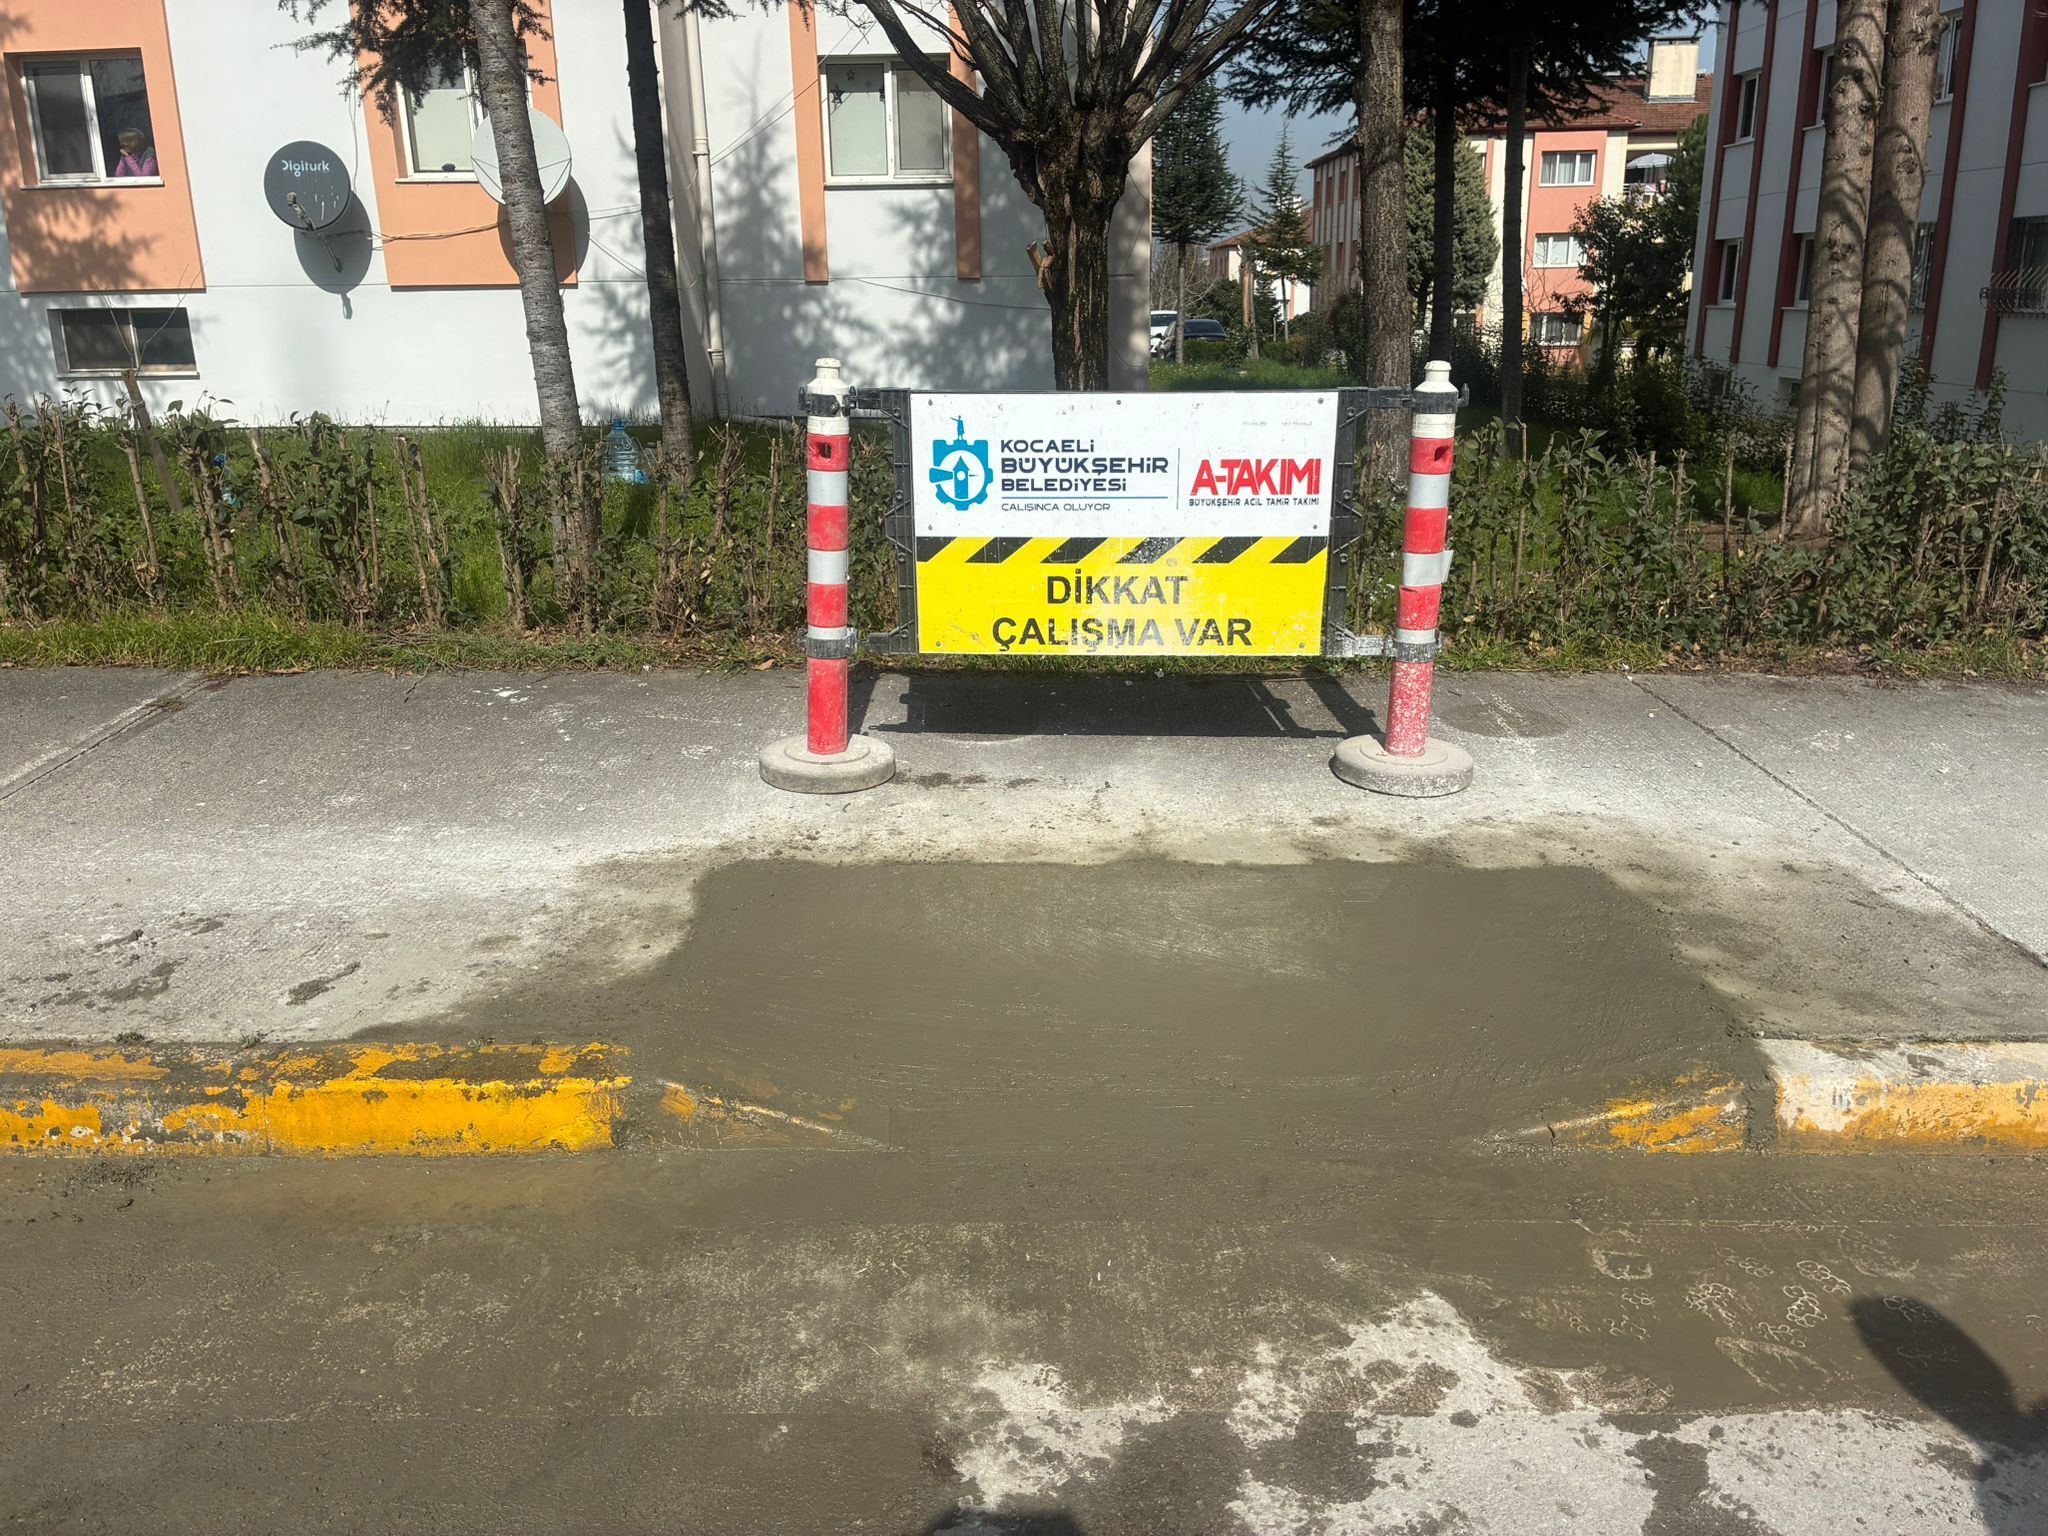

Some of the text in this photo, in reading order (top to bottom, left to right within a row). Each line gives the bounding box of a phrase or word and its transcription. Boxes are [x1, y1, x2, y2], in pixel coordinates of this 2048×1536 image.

[281, 159, 330, 177] Digiturk
[1001, 439, 1094, 453] KOCAELİ
[1001, 457, 1168, 476] BÜYÜKŞEHİR
[1001, 478, 1127, 492] BELEDİYESİ
[1190, 458, 1321, 496] A-TAKIMI
[1001, 503, 1111, 512] ÇALIŞINCA OLUYOR
[1189, 497, 1320, 507] BÜYÜKŞEHİR ACİL TAMİR TAKIMI
[1047, 568, 1188, 605] DİKKAT
[992, 617, 1252, 652] ÇALIŞMA VAR
